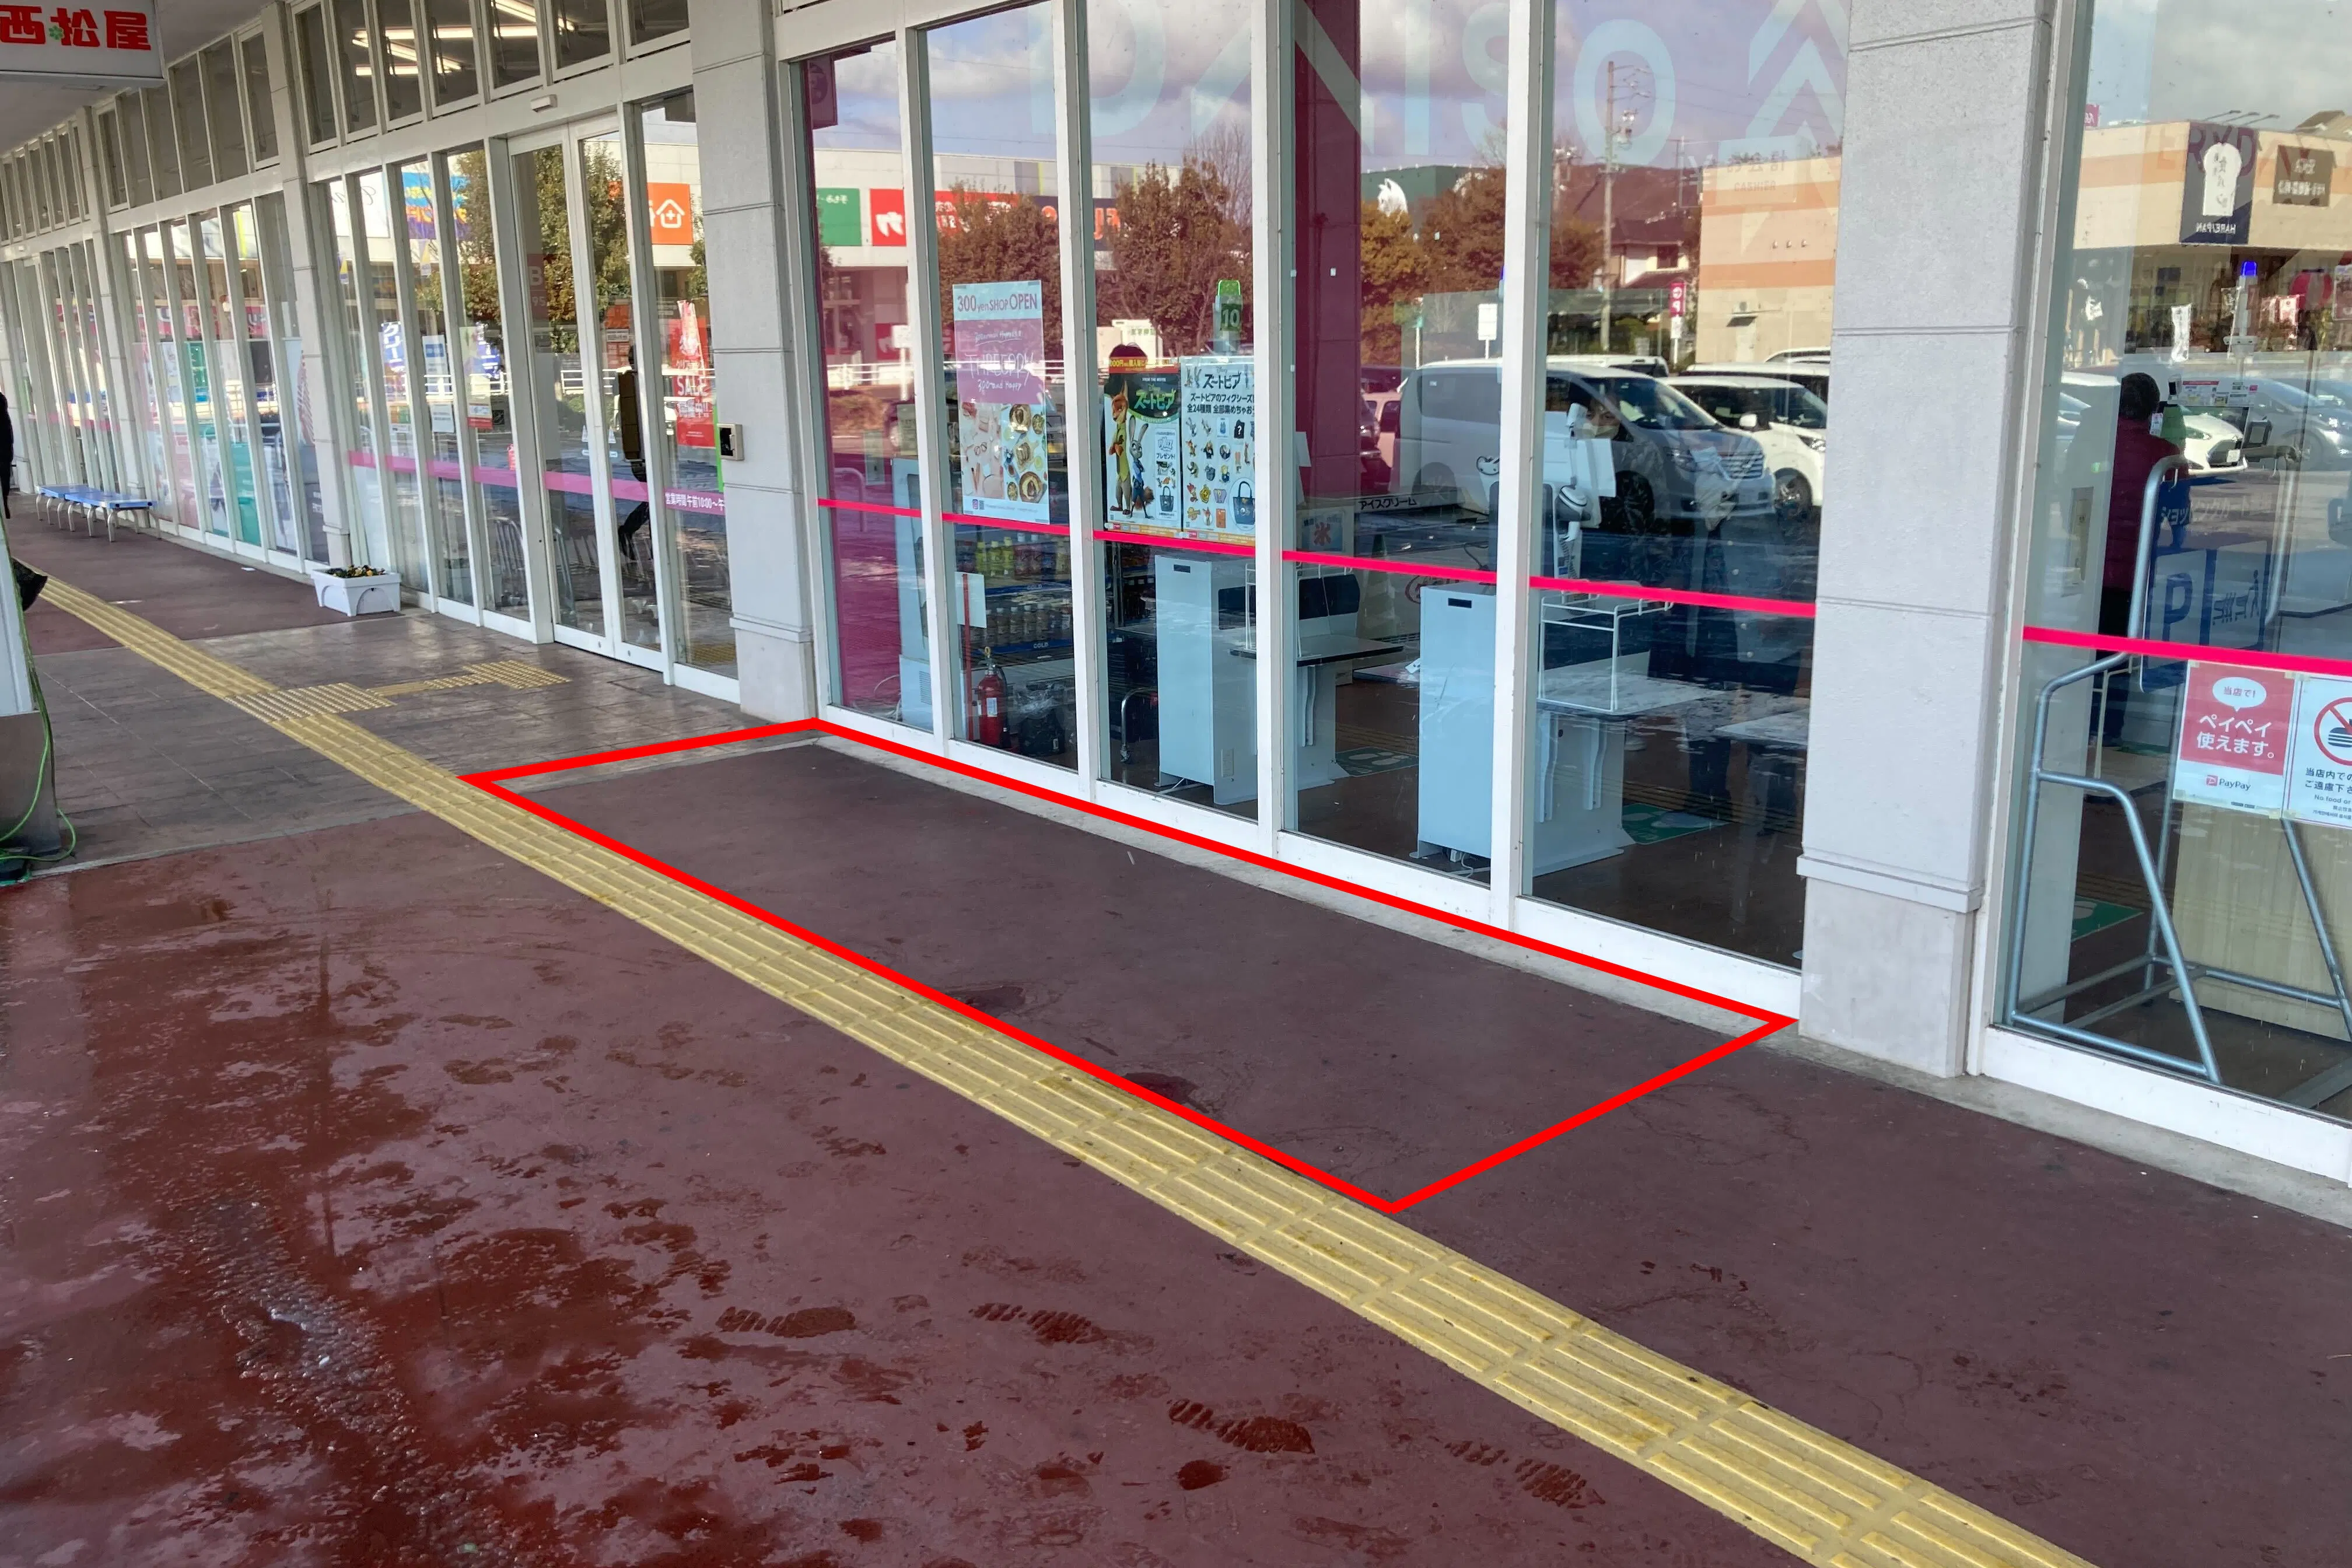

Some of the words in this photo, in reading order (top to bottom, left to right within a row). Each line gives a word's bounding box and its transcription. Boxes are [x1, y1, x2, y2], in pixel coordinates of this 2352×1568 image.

[0, 5, 152, 51] 西松屋
[957, 295, 977, 312] 300
[978, 304, 989, 313] yen
[989, 299, 1008, 311] SHOP
[1009, 293, 1038, 310] OPEN
[1222, 309, 1240, 327] 10
[1202, 371, 1241, 390] ズートピア
[1133, 388, 1176, 410] ズートピア
[1187, 404, 1212, 413] 全24種類
[1358, 497, 1417, 510] アイスクリーム
[2223, 686, 2256, 698] 当店で!
[2199, 714, 2272, 738] ペイペイ
[2197, 731, 2274, 759] 使えます。
[2305, 768, 2352, 780] 当店内での
[2219, 778, 2251, 790] PayPay
